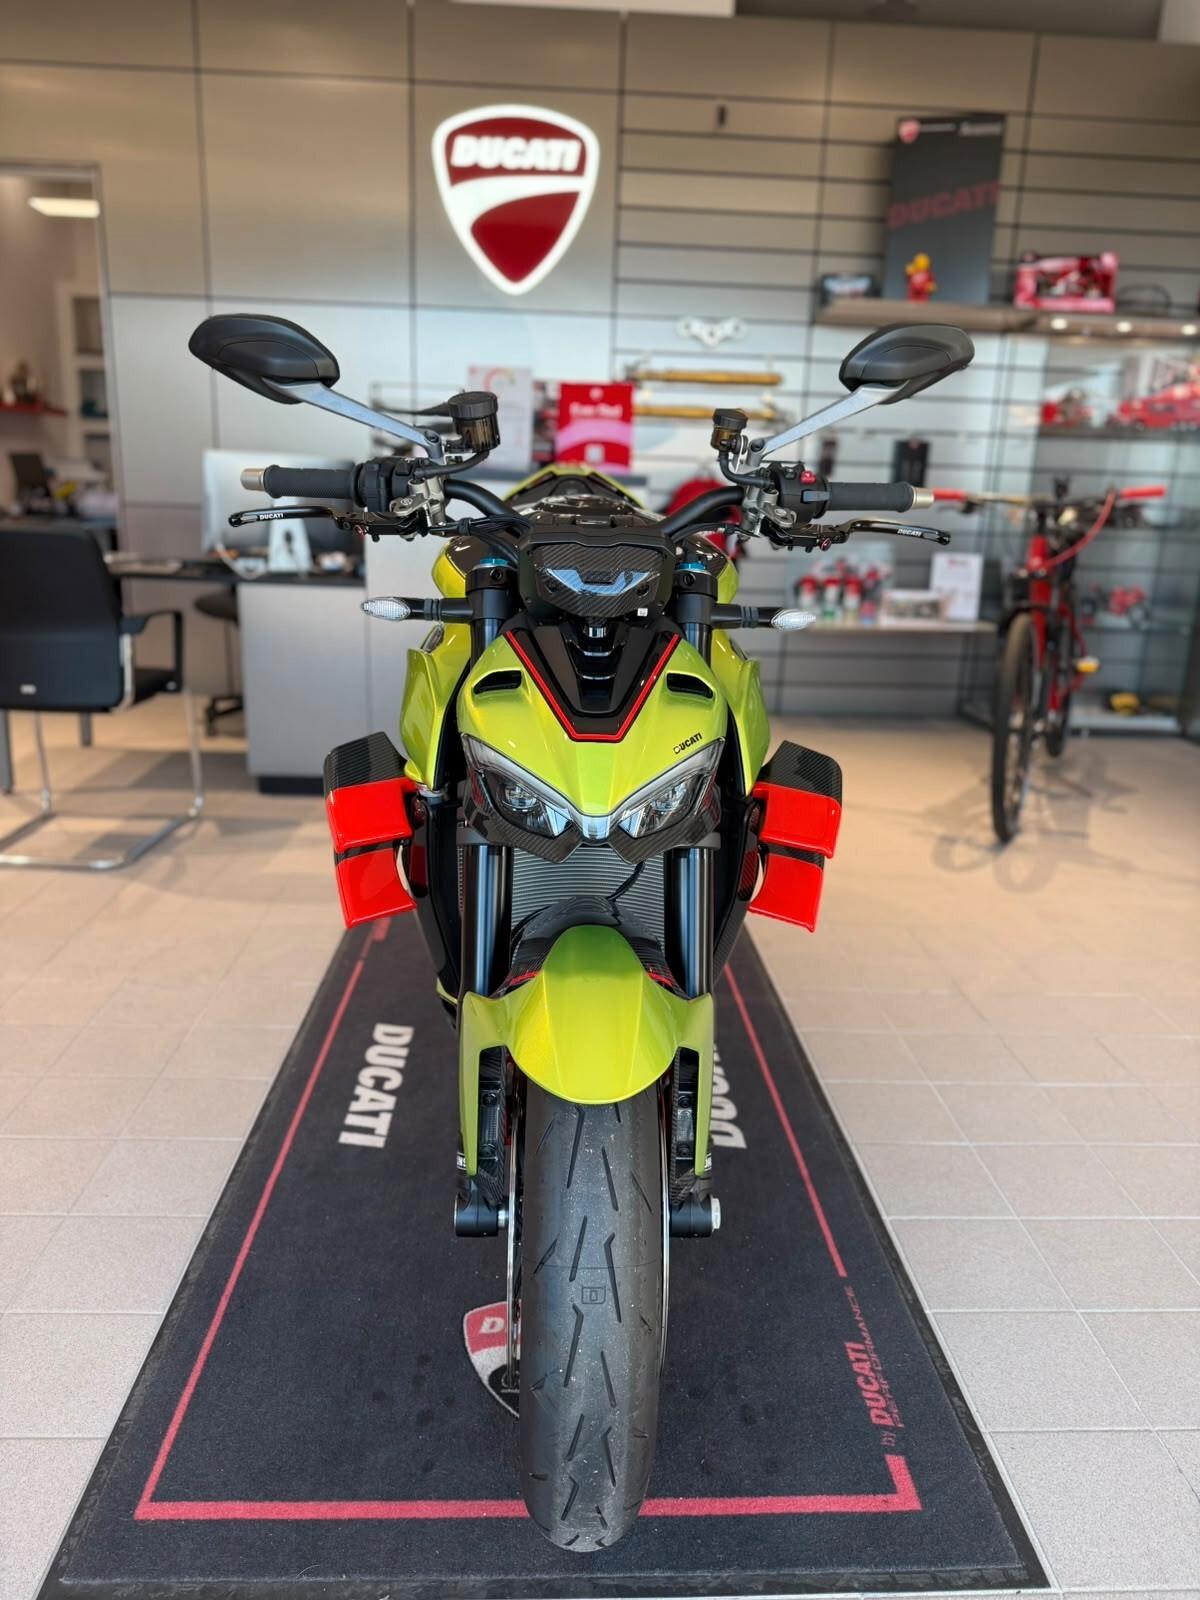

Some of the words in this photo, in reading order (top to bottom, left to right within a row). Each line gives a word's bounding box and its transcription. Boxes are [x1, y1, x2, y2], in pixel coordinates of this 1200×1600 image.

[450, 134, 582, 173] DUCATI
[897, 529, 922, 537] DUCATI
[673, 733, 703, 754] DUCATI
[338, 1022, 415, 1148] DUCATI
[845, 1341, 894, 1426] DUCATI
